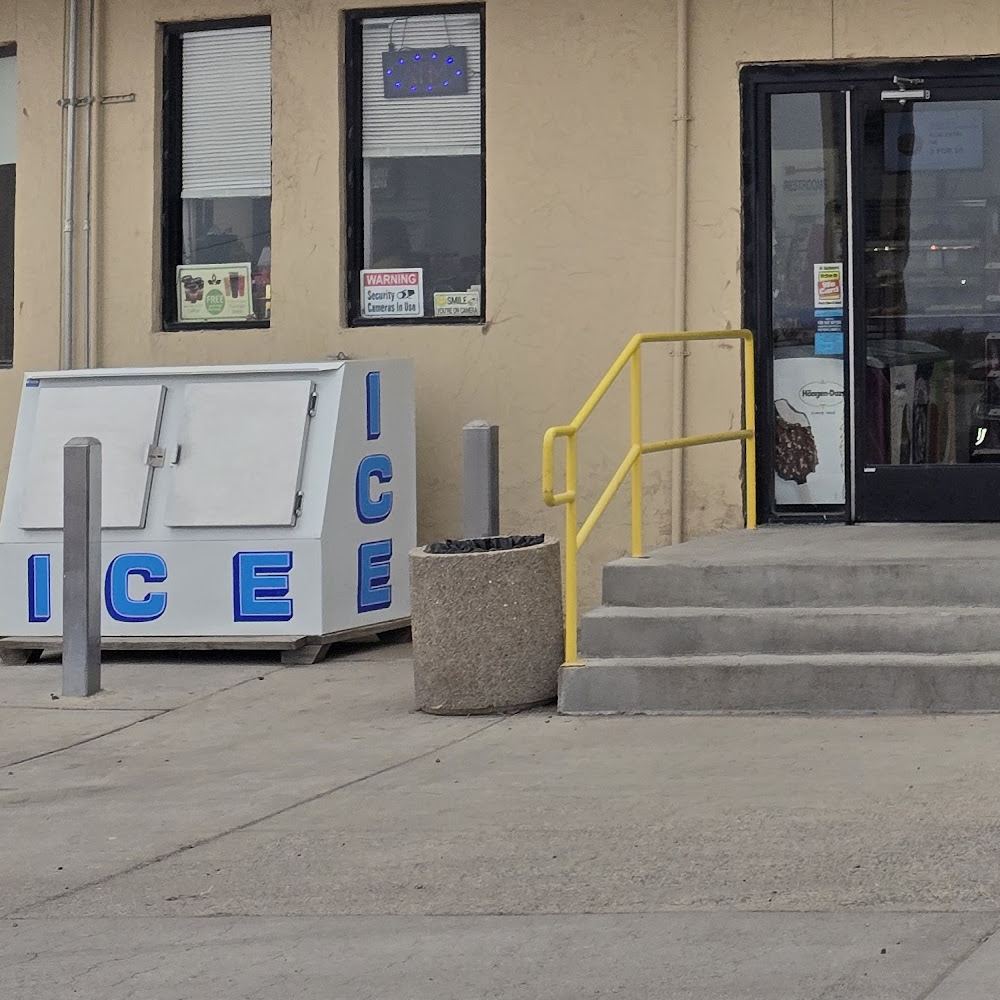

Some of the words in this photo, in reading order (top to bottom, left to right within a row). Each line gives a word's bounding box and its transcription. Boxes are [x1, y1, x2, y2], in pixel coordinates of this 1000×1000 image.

[366, 273, 417, 285] WARNING
[206, 295, 224, 304] FREE
[367, 290, 395, 301] Security
[447, 296, 467, 305] SMILE
[367, 302, 395, 312] Cameras
[396, 302, 403, 312] In
[404, 302, 416, 312] Use
[802, 389, 844, 399] Häagen-Daz
